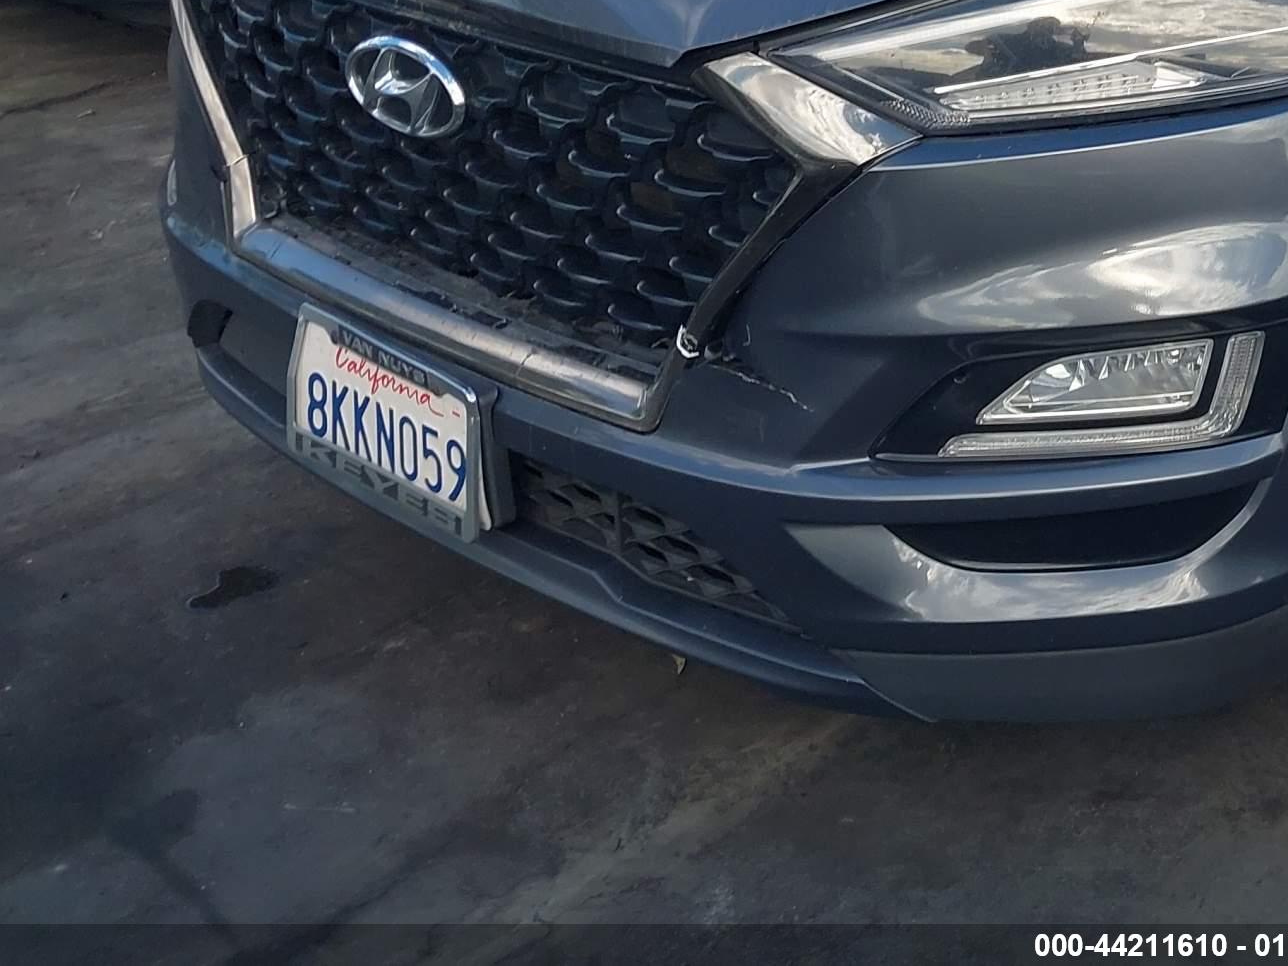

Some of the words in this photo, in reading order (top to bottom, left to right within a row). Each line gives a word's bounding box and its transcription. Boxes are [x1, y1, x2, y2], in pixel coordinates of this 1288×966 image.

[335, 346, 444, 418] California
[342, 331, 373, 358] VAN
[378, 351, 427, 384] NUYS
[307, 371, 467, 503] 8KKN059
